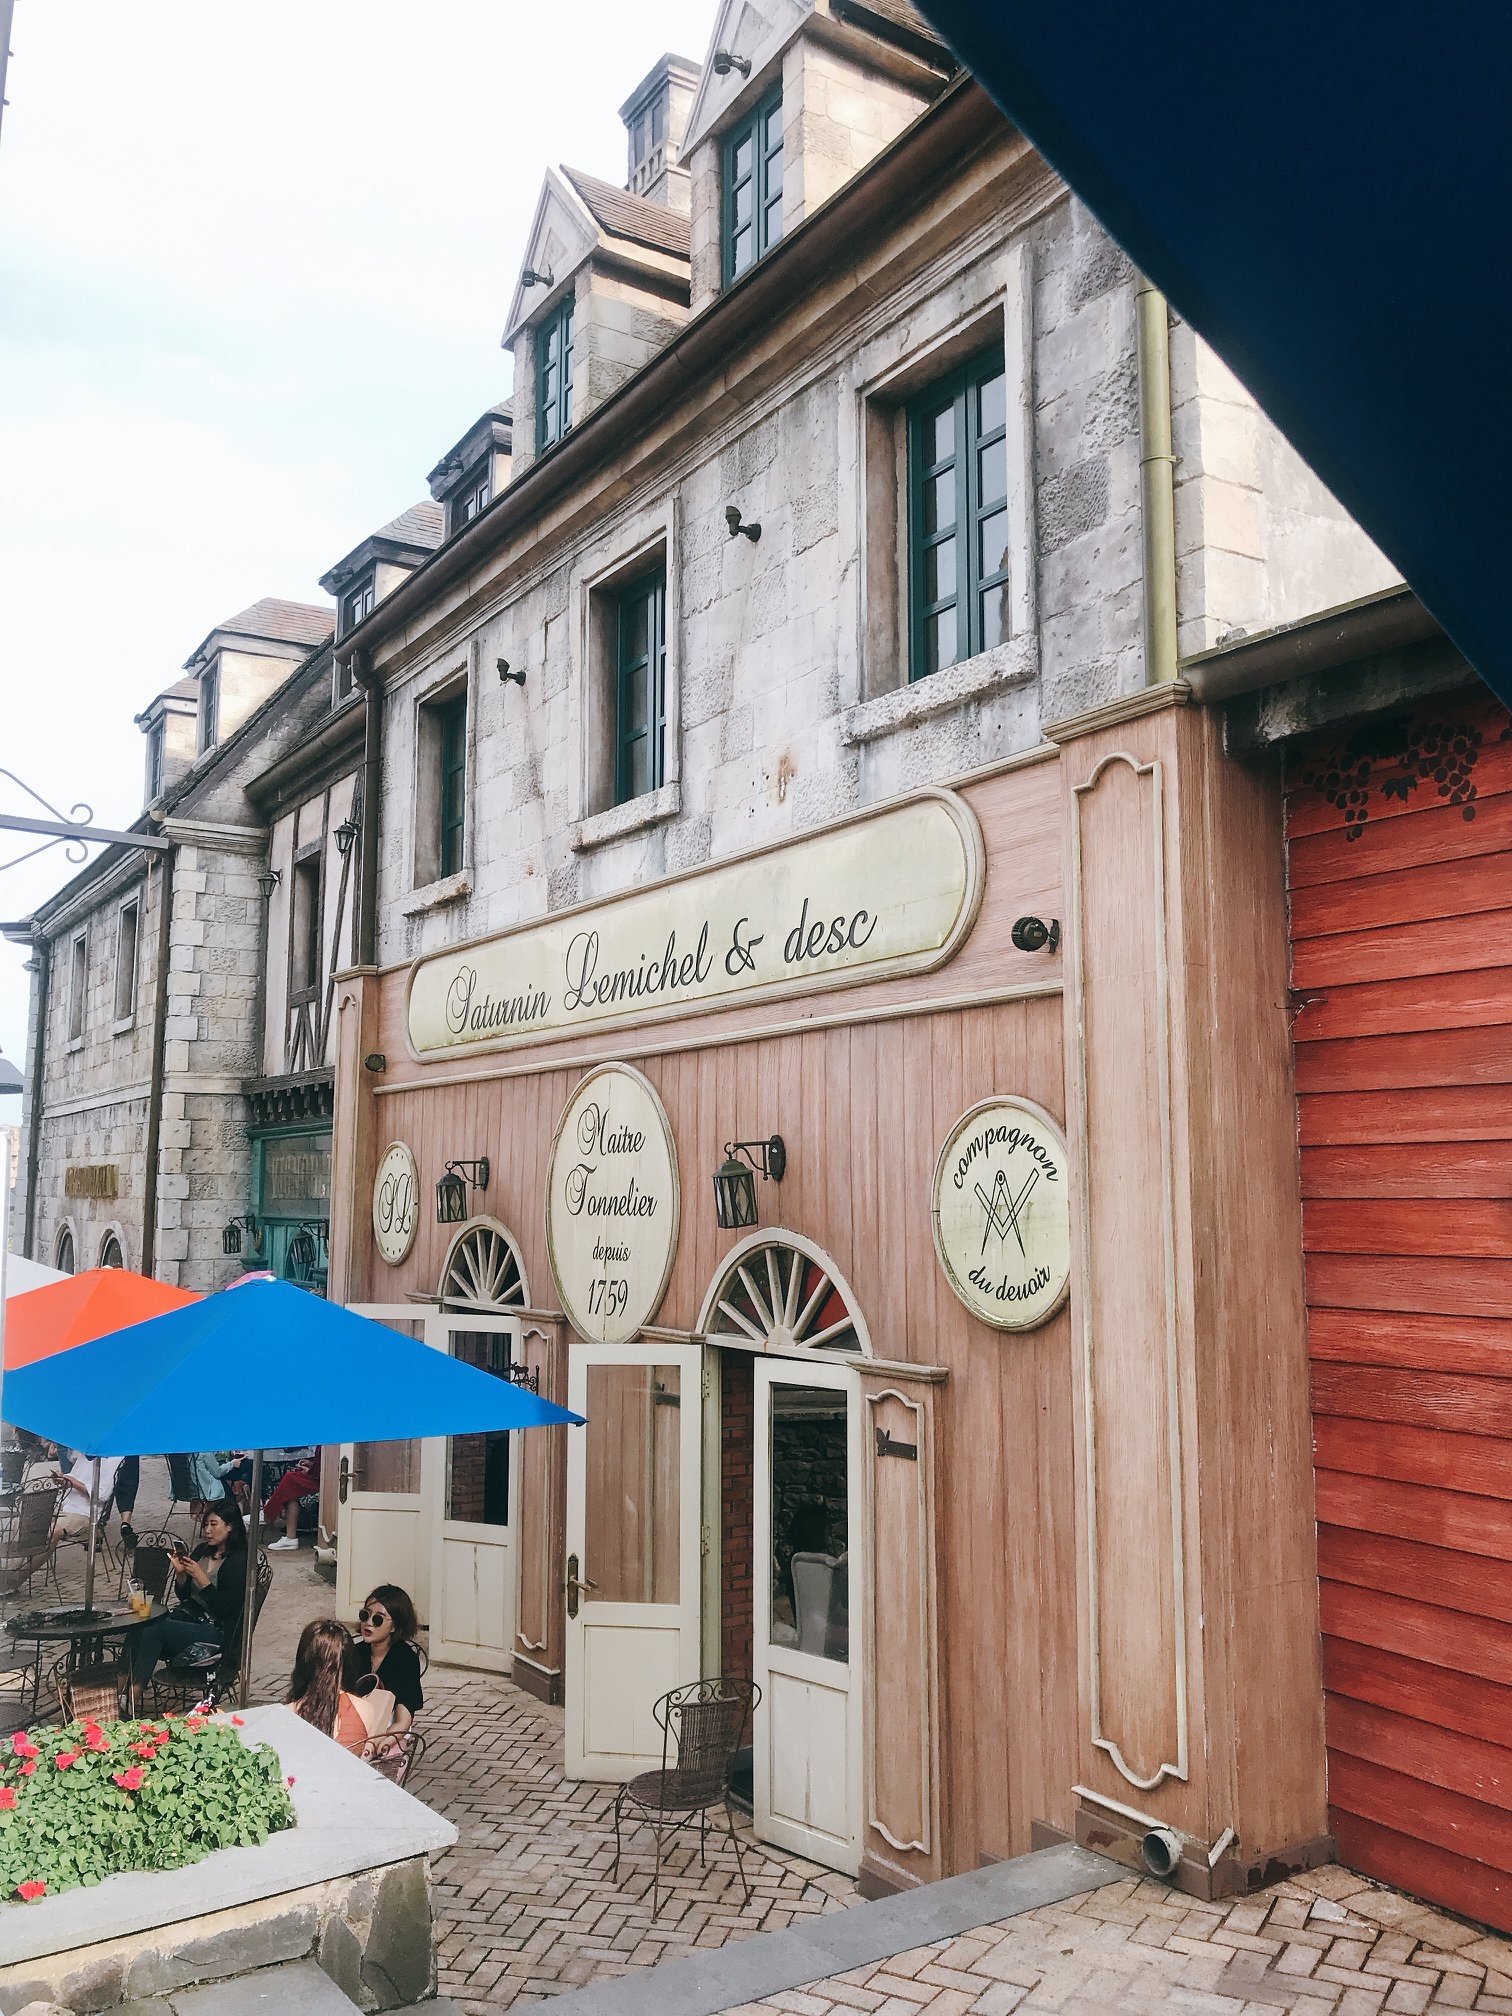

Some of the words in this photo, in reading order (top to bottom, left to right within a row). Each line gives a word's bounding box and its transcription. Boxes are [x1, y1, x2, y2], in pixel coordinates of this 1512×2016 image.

[446, 965, 551, 1035] Saturnin
[562, 920, 713, 1011] Lemichel
[725, 917, 765, 976] &
[783, 897, 878, 964] desc
[953, 1125, 1059, 1190] compagnon
[564, 1163, 658, 1218] Tonnelier
[592, 1235, 631, 1270] depuis
[588, 1278, 629, 1318] 1759
[968, 1265, 995, 1294] du
[995, 1265, 1052, 1302] devoir
